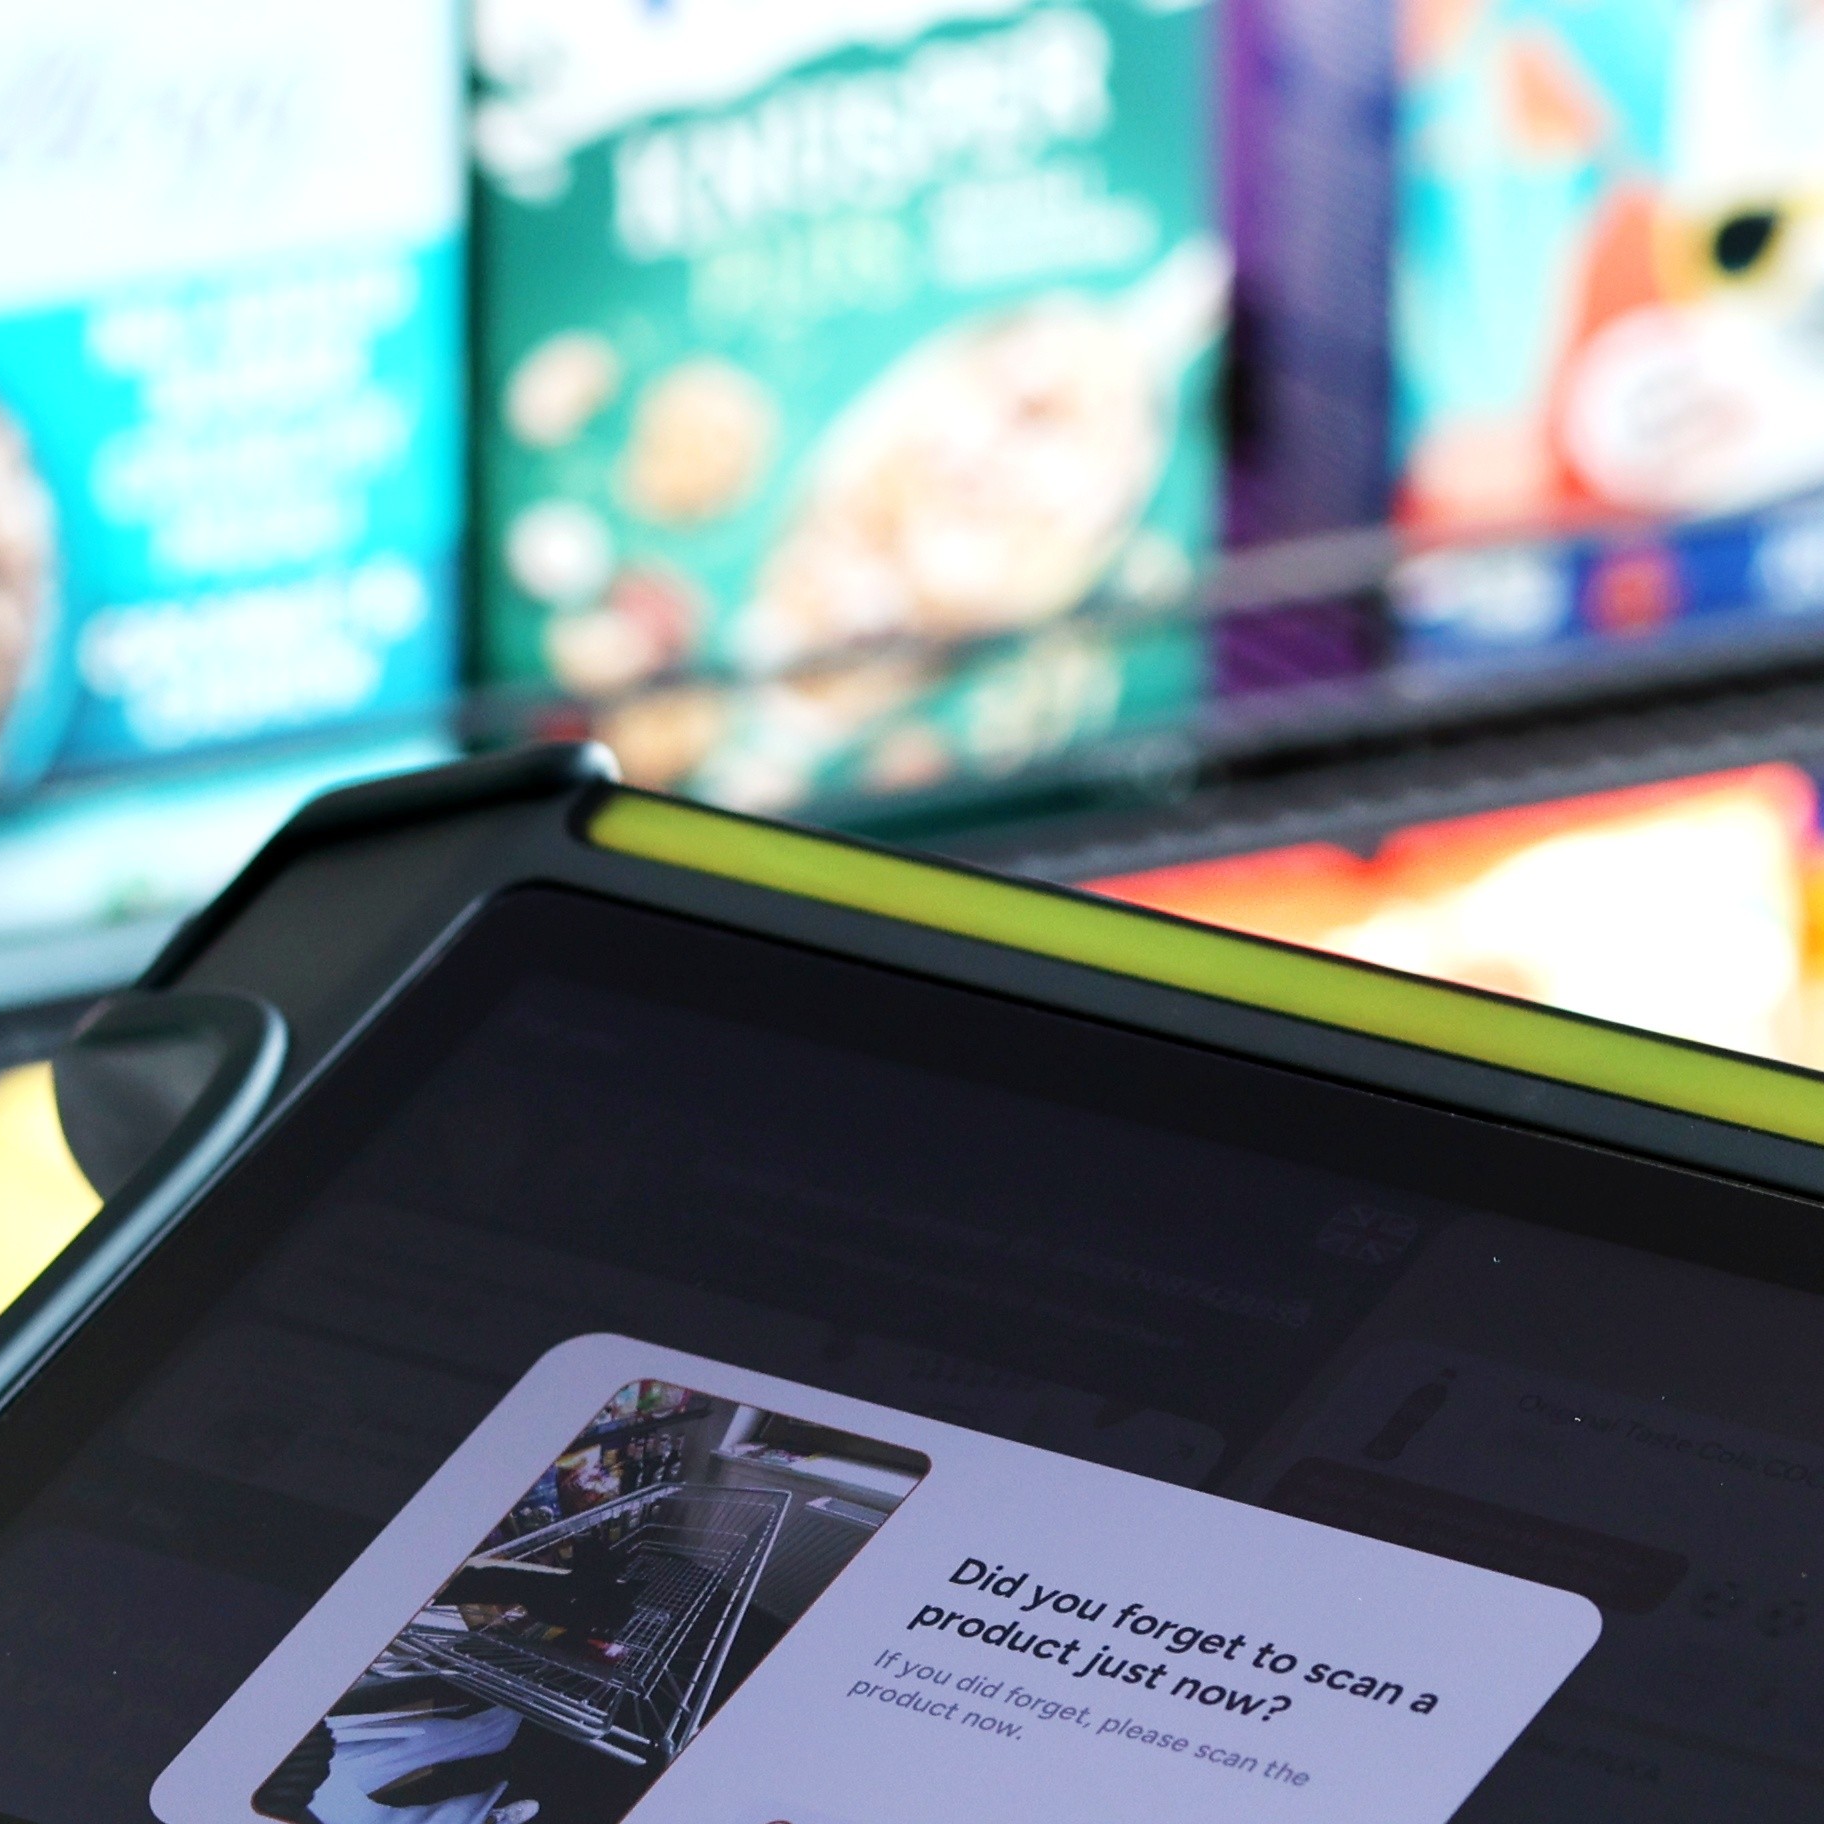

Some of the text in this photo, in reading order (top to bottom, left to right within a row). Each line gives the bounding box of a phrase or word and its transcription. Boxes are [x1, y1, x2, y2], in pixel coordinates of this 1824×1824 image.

[906, 1604, 1293, 1722] product just now?
[948, 1557, 1440, 1715] Did you forget to scan a
[846, 1679, 1024, 1741] product now.
[873, 1648, 1311, 1787] If you did forget, please scan the
